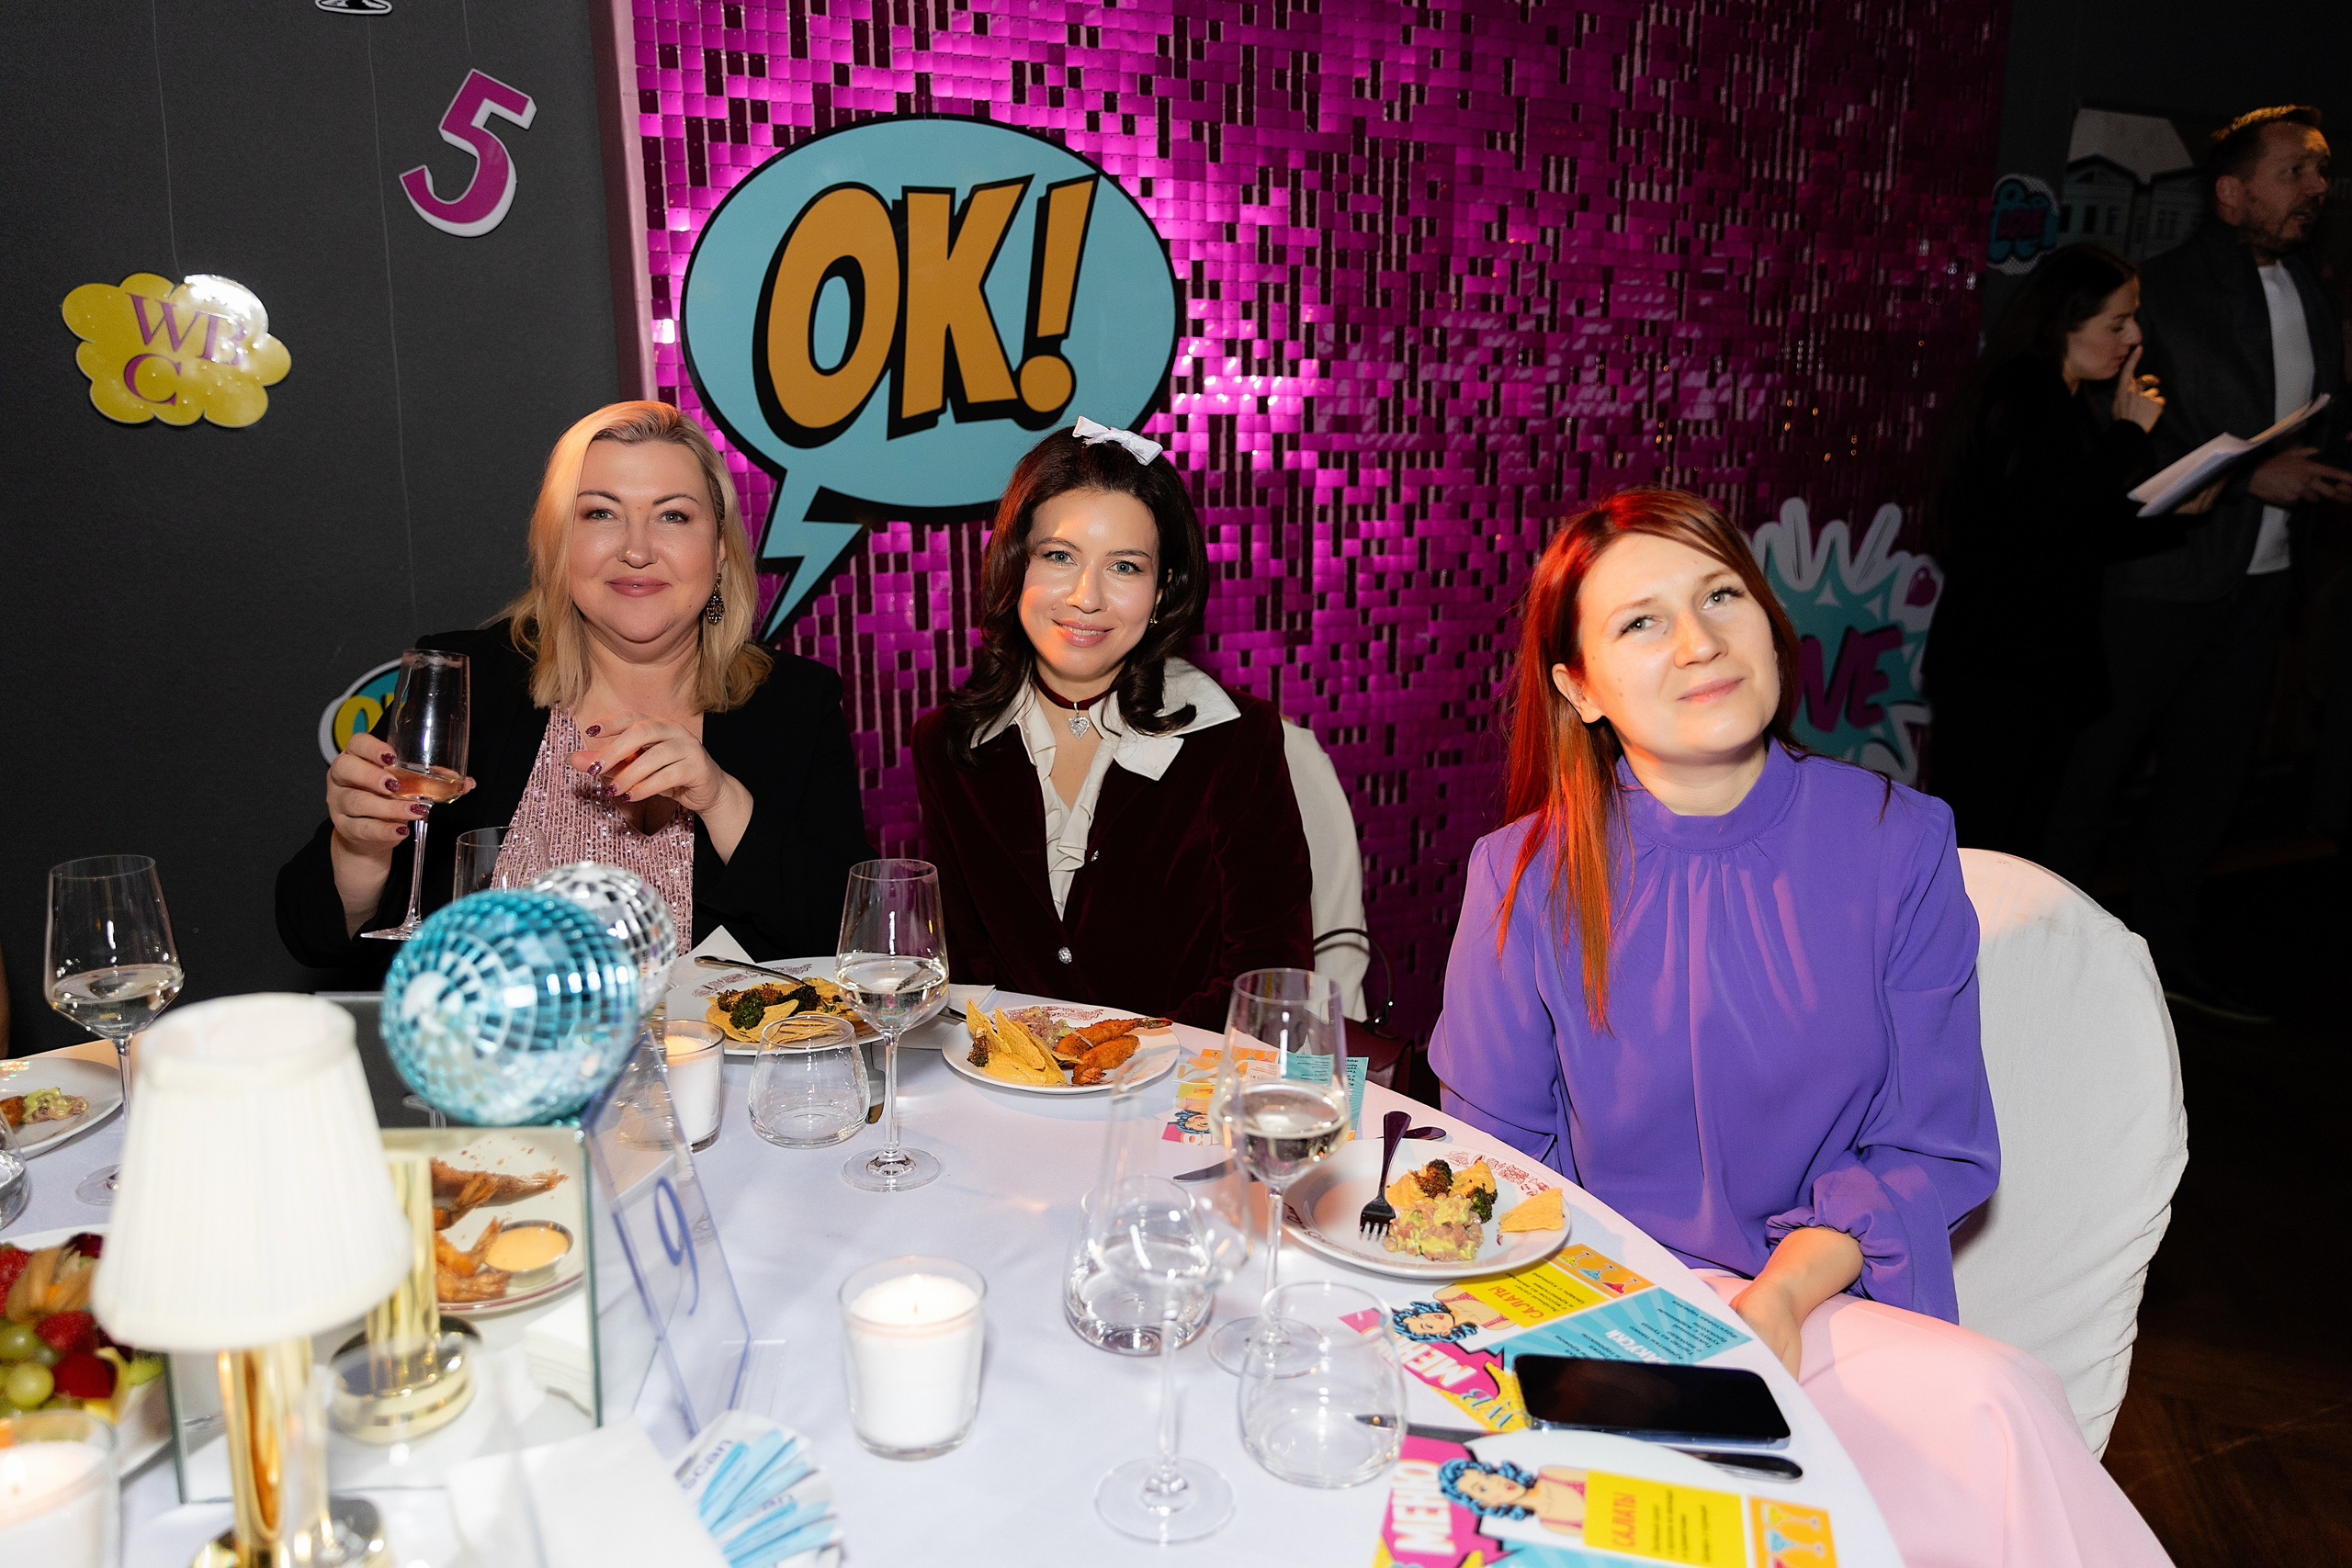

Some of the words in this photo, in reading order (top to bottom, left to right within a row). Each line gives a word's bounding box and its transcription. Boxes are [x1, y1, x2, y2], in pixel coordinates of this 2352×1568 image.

[400, 69, 537, 236] 5
[752, 174, 1101, 448] OK!
[654, 1177, 698, 1316] 9
[1488, 1286, 1544, 1318] САЛАТЫ
[1605, 1329, 1668, 1364] АКУСКИ
